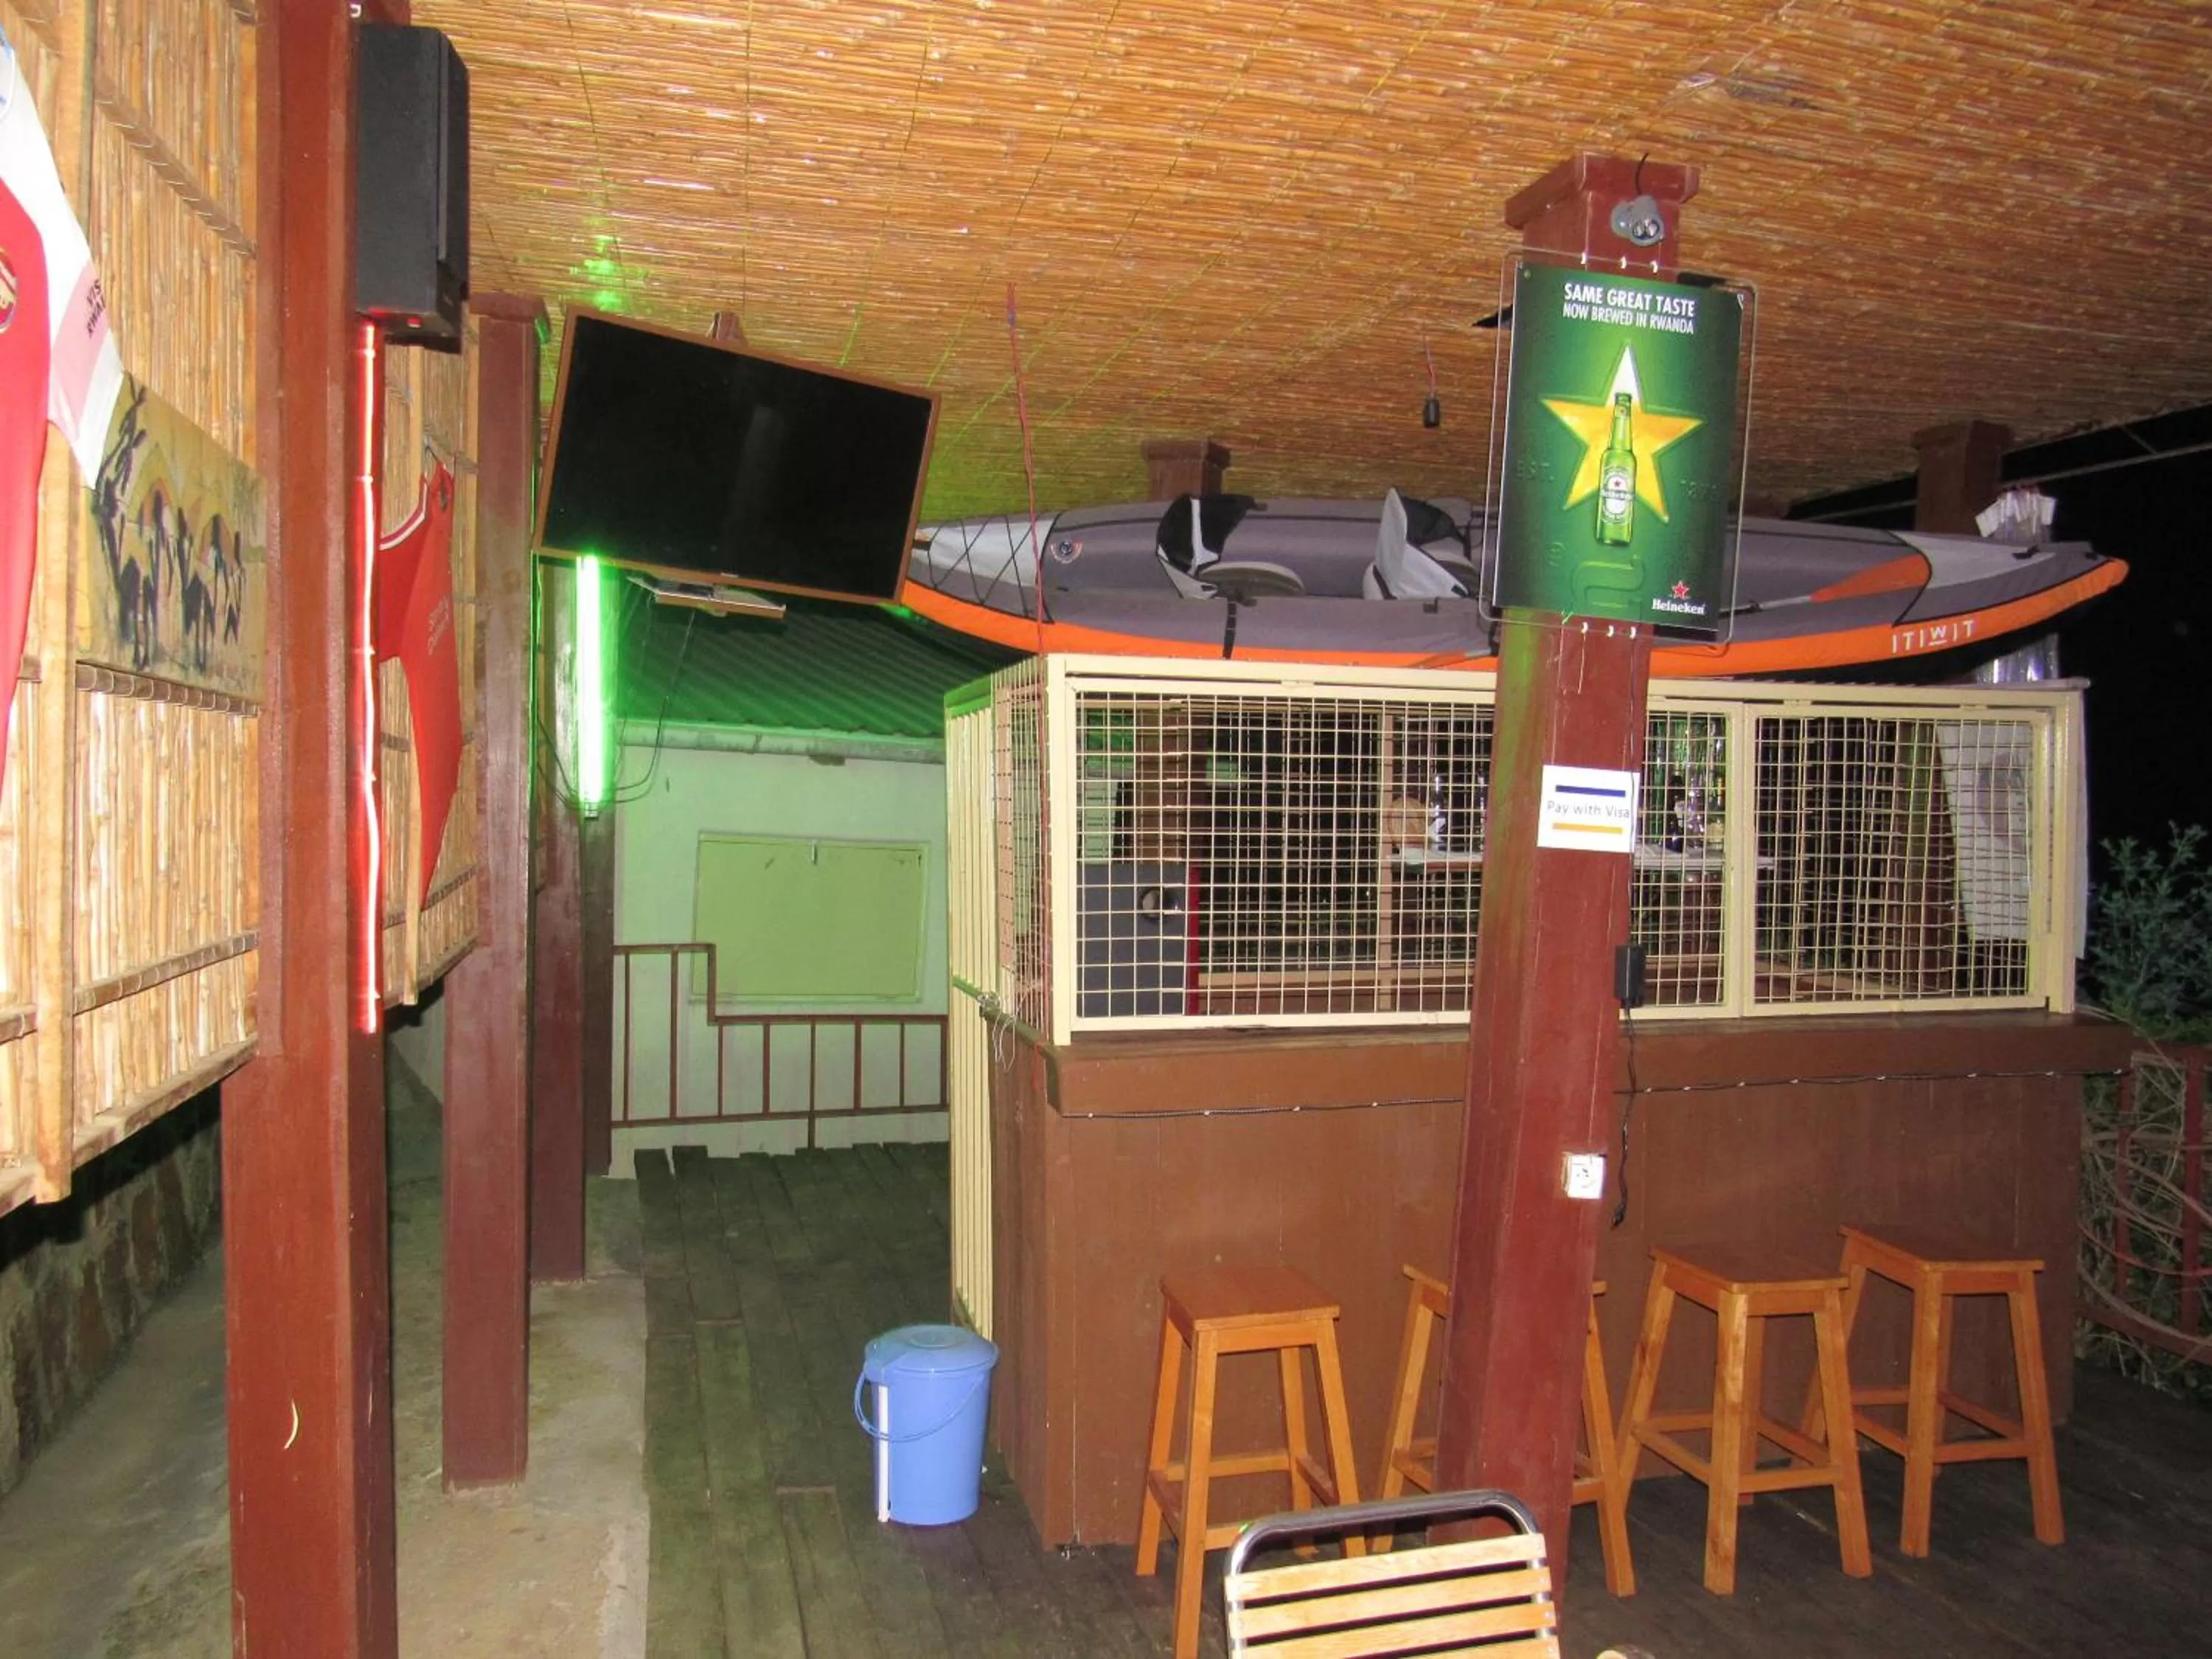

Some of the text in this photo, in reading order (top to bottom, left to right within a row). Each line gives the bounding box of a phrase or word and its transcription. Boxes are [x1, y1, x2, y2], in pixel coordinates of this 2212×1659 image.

[1564, 282, 1695, 318] SAME GREAT TASTE
[1562, 302, 1694, 335] NOW BREWED IN RWANDA
[1652, 598, 1705, 616] Heineken
[1892, 620, 1974, 653] ITIWIT
[1547, 800, 1630, 818] Pay with Visa
